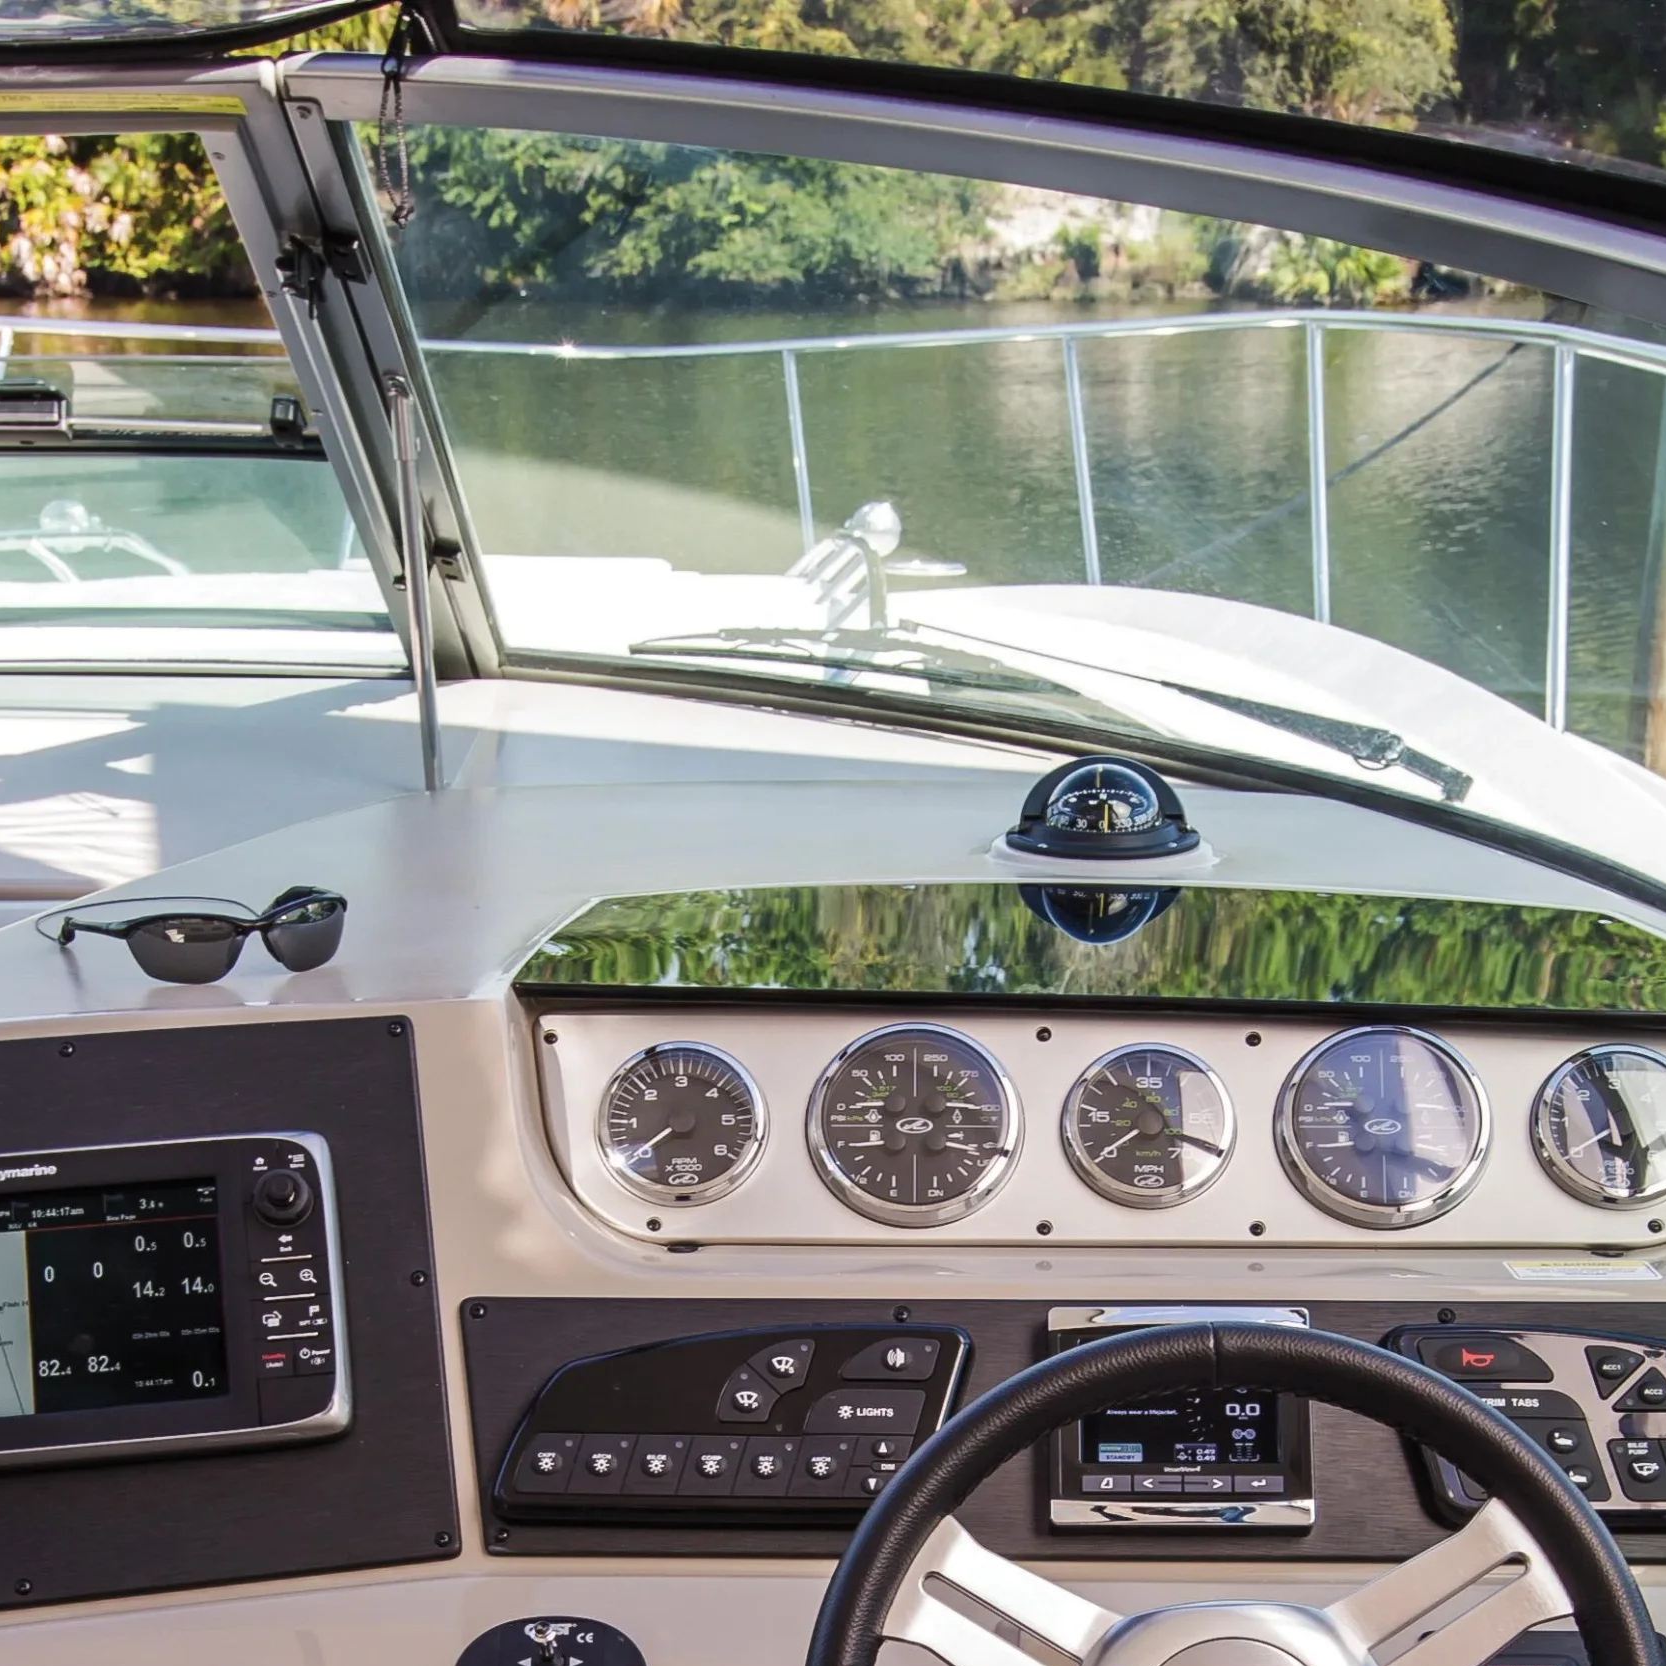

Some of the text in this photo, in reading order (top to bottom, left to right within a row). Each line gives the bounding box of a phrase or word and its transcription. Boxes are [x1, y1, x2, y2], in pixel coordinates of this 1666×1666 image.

[1076, 819, 1087, 828] 30
[884, 1054, 905, 1062] 100
[923, 1054, 948, 1062] 250
[959, 1070, 979, 1078] 175
[675, 1076, 688, 1087] 3
[1136, 1077, 1163, 1088] 35
[644, 1089, 657, 1100] 2
[705, 1088, 719, 1098] 4
[721, 1115, 735, 1125] 5
[1088, 1111, 1110, 1122] 15
[629, 1118, 637, 1128] 1
[639, 1147, 651, 1158] 0
[714, 1144, 727, 1155] 6
[1134, 1165, 1164, 1173] MPH
[31, 1207, 84, 1218] 10:44:17am
[135, 1232, 206, 1252] 0.5 0.5
[44, 1262, 103, 1282] 0 0
[133, 1276, 214, 1298] 14.2 14.0
[39, 1356, 121, 1377] 82.4 82.4
[192, 1370, 215, 1387] 0.1
[1480, 1398, 1540, 1408] TRIM TABS
[856, 1407, 894, 1418] LIGHTS
[1225, 1403, 1260, 1416] 0.0
[576, 1633, 593, 1643] CE
